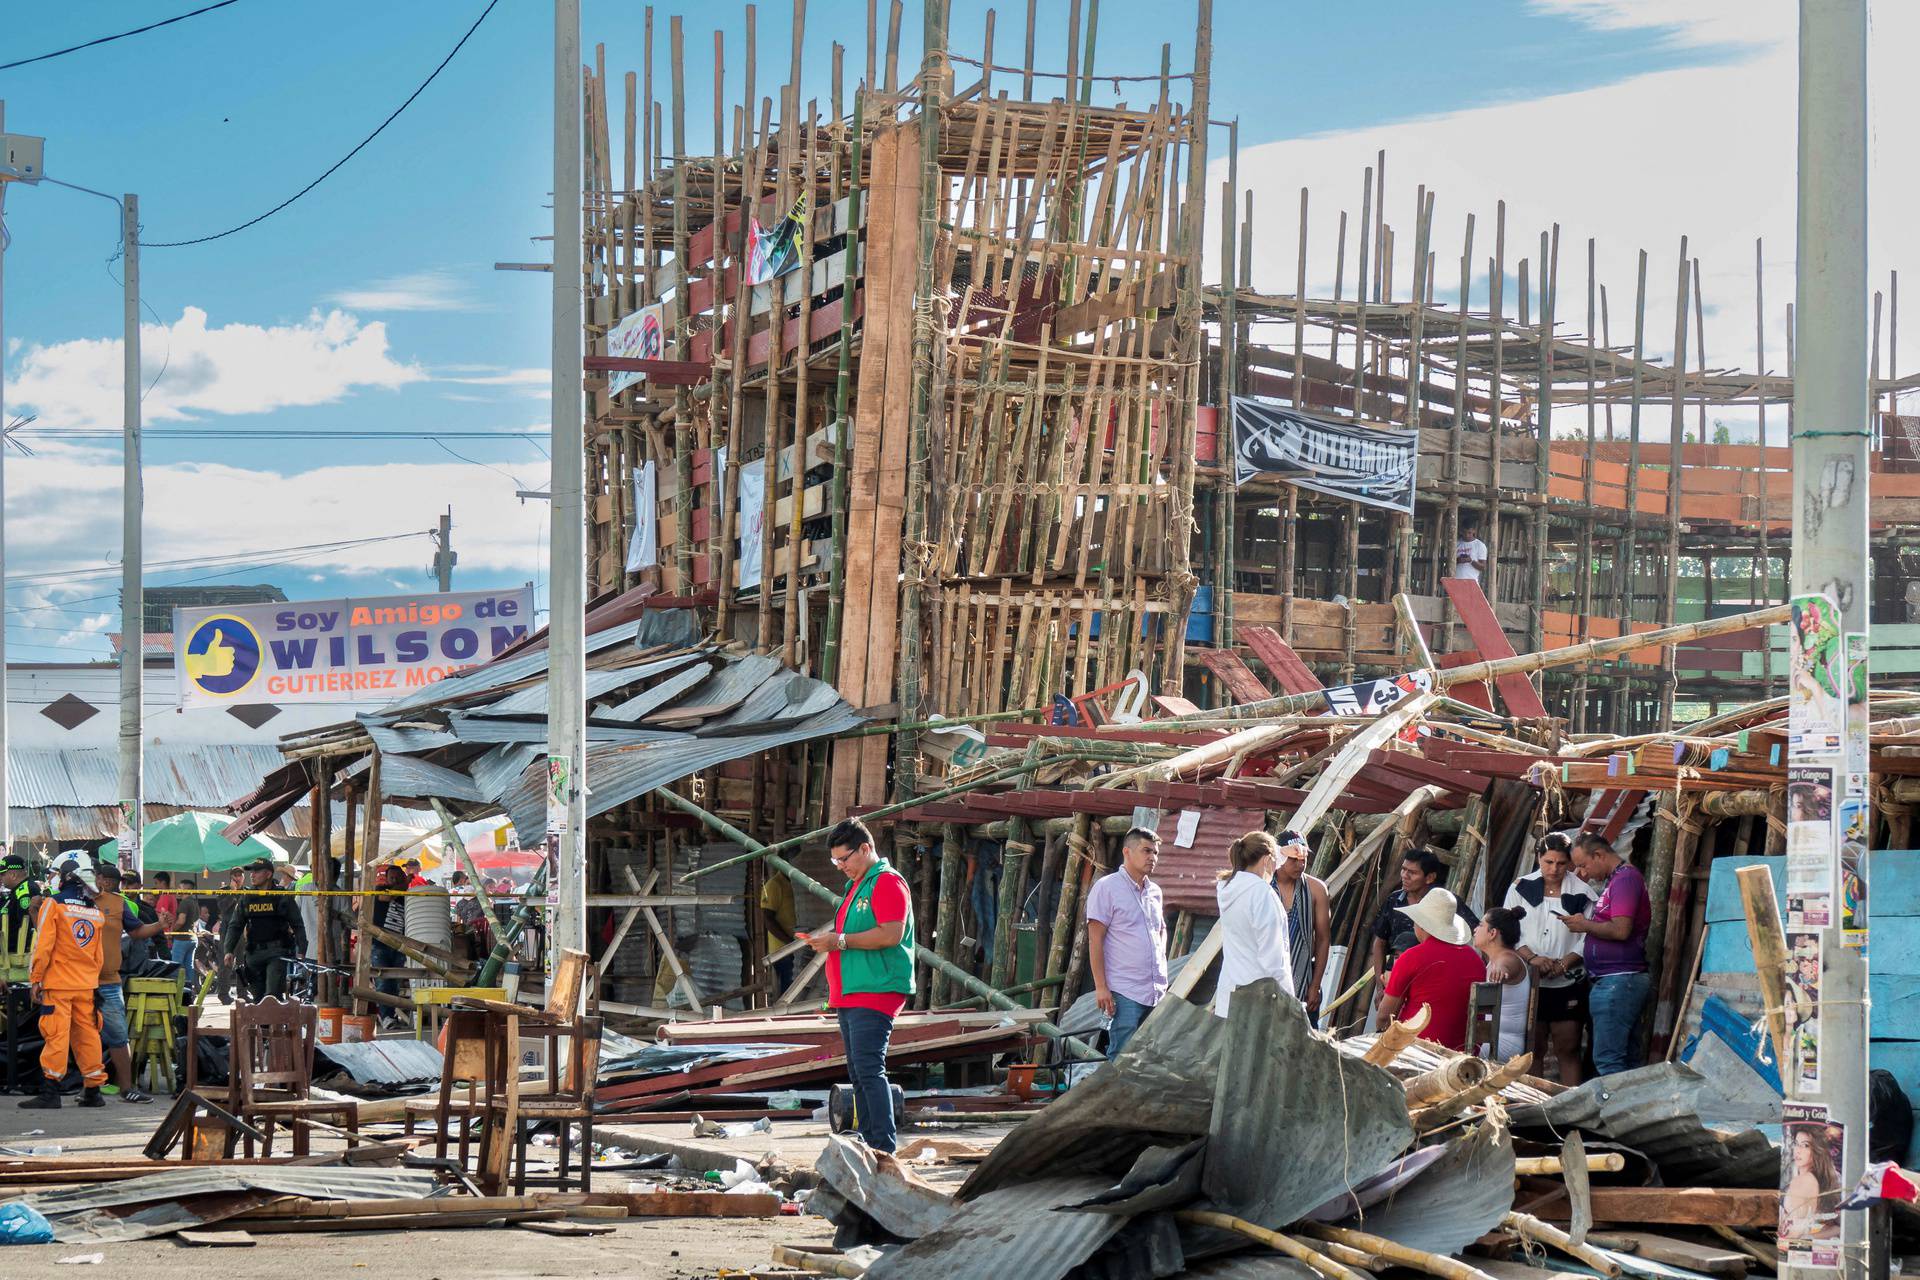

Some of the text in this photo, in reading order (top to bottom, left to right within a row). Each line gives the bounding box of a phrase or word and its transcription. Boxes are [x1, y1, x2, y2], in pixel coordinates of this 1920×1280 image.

[275, 597, 518, 632] Soy Amigo de
[269, 624, 528, 670] WILSON
[267, 667, 397, 695] GUTIÉRREZ
